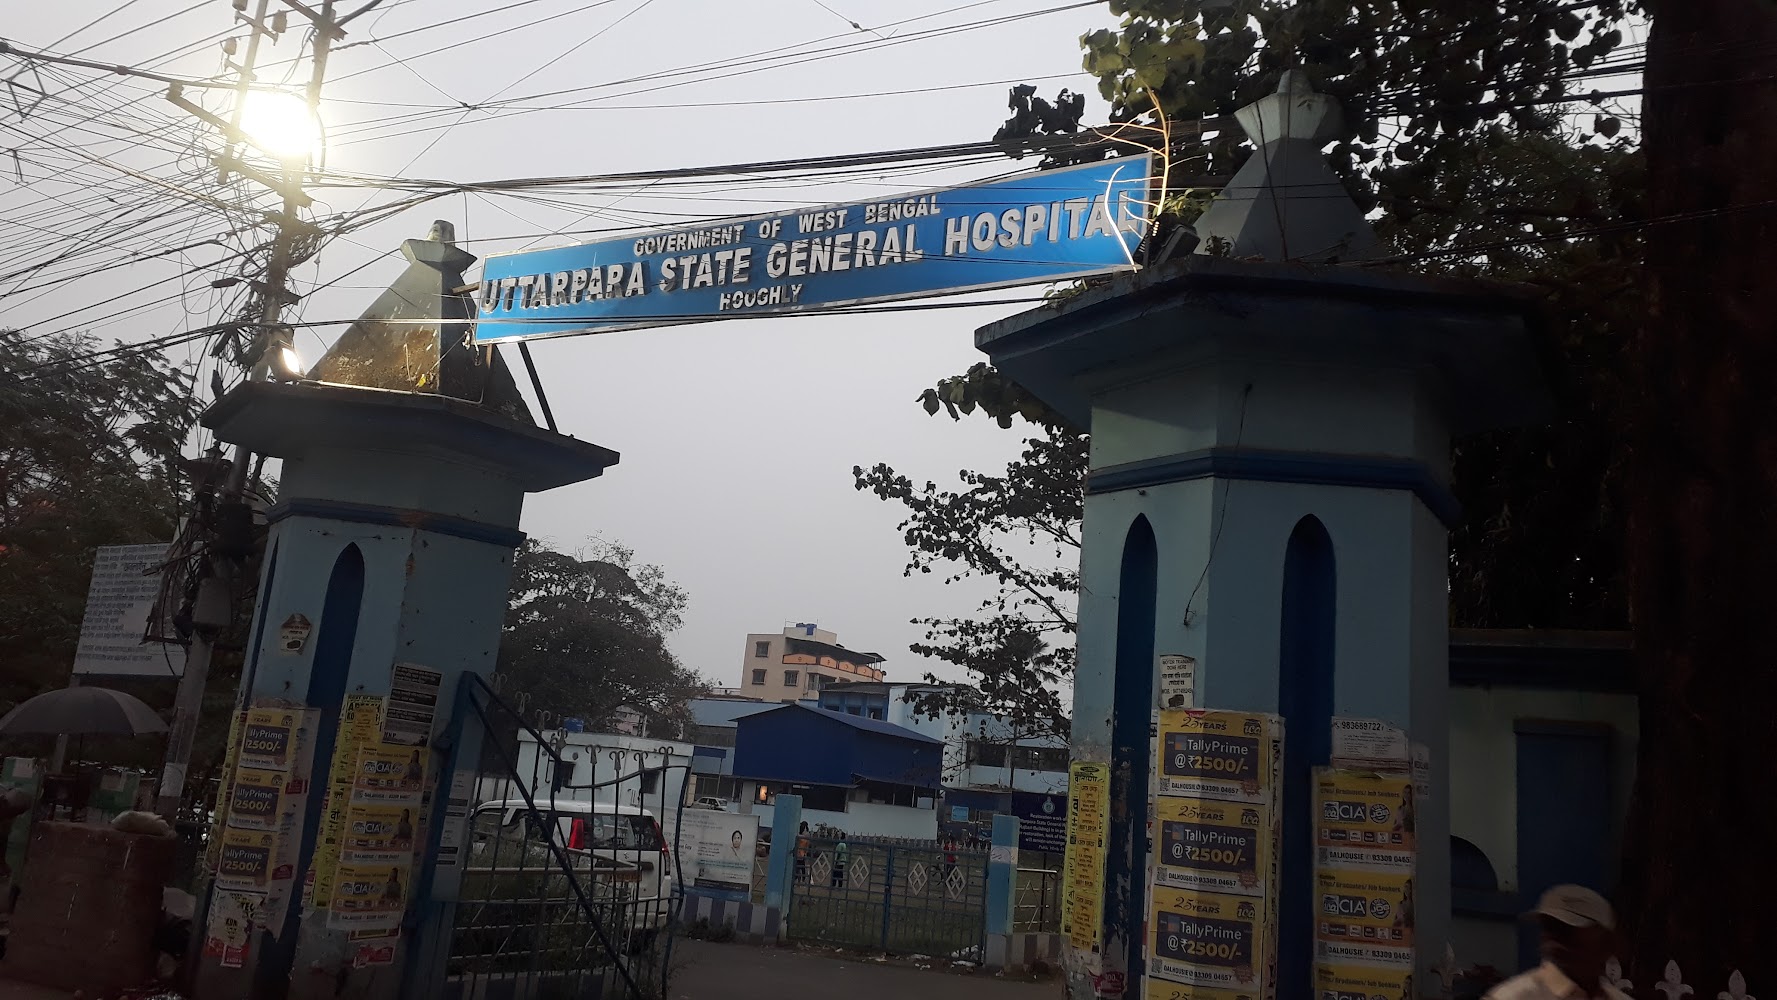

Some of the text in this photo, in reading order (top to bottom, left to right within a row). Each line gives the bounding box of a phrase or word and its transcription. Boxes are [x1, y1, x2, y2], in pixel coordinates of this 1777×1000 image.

[633, 195, 941, 257] GOVERNMENT OF WEST BENGAL
[479, 190, 1138, 314] UTTARPARA STATE GENERAL HOSPITAL
[1180, 716, 1228, 731] 25 YEARS
[250, 728, 283, 739] llyPrime
[1187, 738, 1249, 755] TallyPrime
[1178, 805, 1225, 821] 25 YEARS
[1339, 804, 1366, 820] CIA
[1184, 828, 1246, 847] TallyPrime
[1393, 856, 1412, 864] 0465
[1168, 872, 1193, 881] DALHOUSIE
[1173, 896, 1220, 914] 25 YEARS
[1339, 899, 1366, 914] CIA
[1180, 920, 1242, 940] TallyPrime
[1393, 952, 1411, 960] 0465
